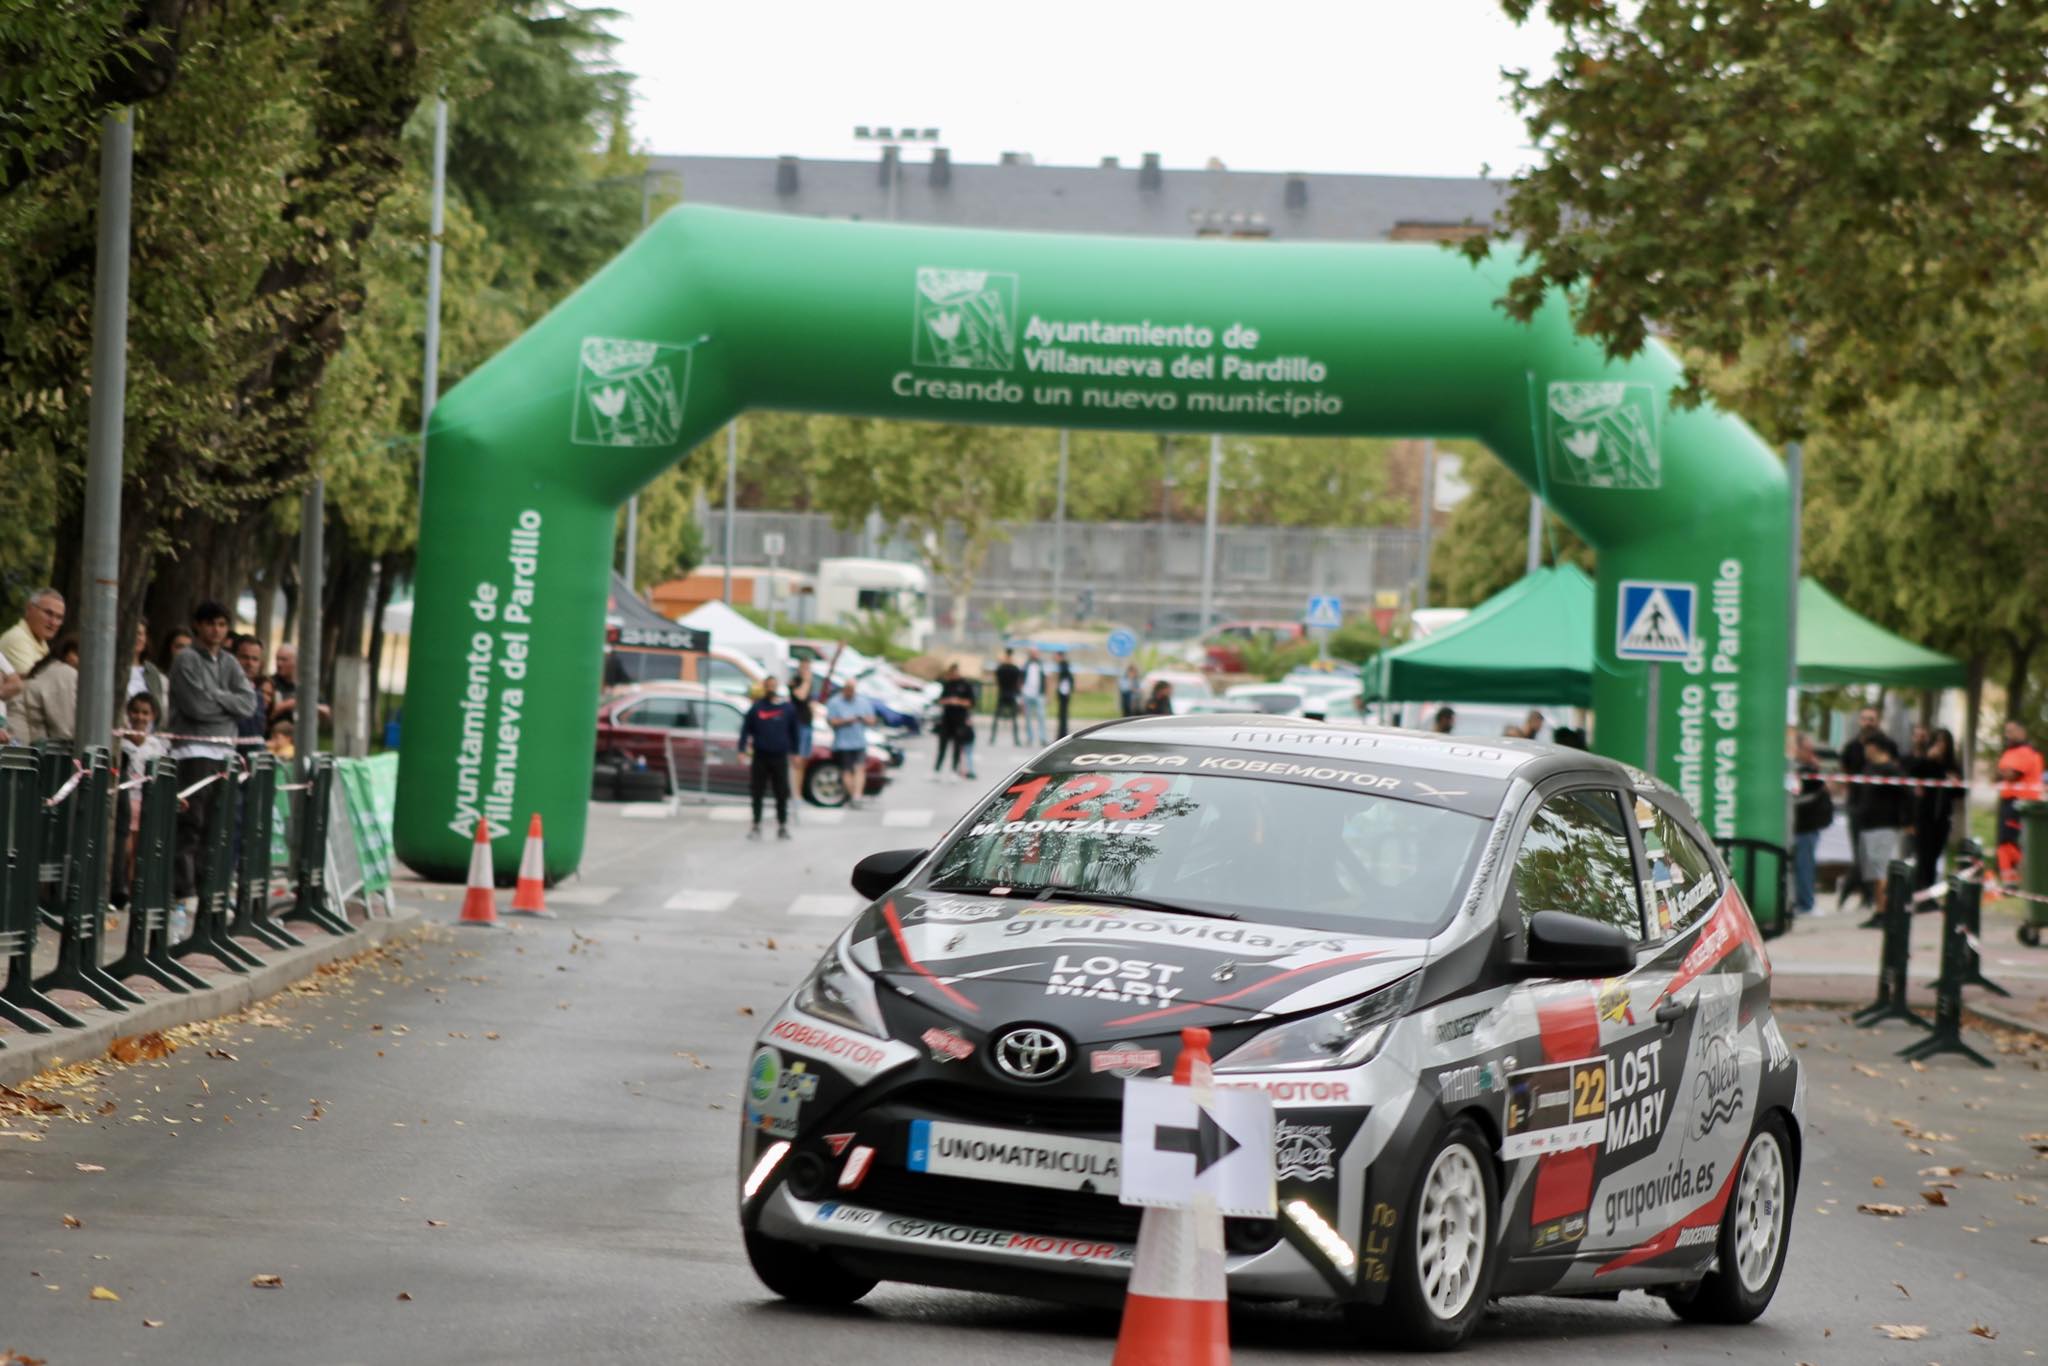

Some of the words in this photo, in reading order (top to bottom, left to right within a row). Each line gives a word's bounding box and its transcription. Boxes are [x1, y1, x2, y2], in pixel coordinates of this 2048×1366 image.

[1024, 314, 1213, 349] Ayuntamiento
[1223, 323, 1259, 350] de
[1023, 347, 1163, 378] Villanueva
[1171, 355, 1214, 380] del
[1222, 356, 1326, 384] Pardillo
[892, 371, 1024, 403] Creando
[1034, 385, 1073, 407] un
[1083, 385, 1177, 411] nuevo
[1187, 384, 1343, 418] municipio
[504, 509, 542, 624] Pardillo
[470, 581, 498, 622] de
[1711, 558, 1742, 675] Pardillo
[499, 632, 530, 680] del
[1710, 681, 1739, 731] del
[448, 632, 494, 839] Ayuntamiento
[484, 688, 524, 839] Villanueva
[1070, 753, 1189, 767] COPA
[1198, 756, 1401, 792] KOBEMOTOR
[1004, 773, 1175, 822] 123
[1004, 915, 1349, 954] grupovida.es
[1045, 973, 1184, 1009] MARY
[1051, 954, 1184, 984] LOST
[768, 1019, 887, 1069] KOBEMOTOR
[1574, 1067, 1605, 1118] 22
[1608, 1038, 1663, 1103] LOST
[1605, 1088, 1667, 1155] MARY
[836, 1206, 873, 1225] UNO
[1604, 1157, 1716, 1238] grupovida.es
